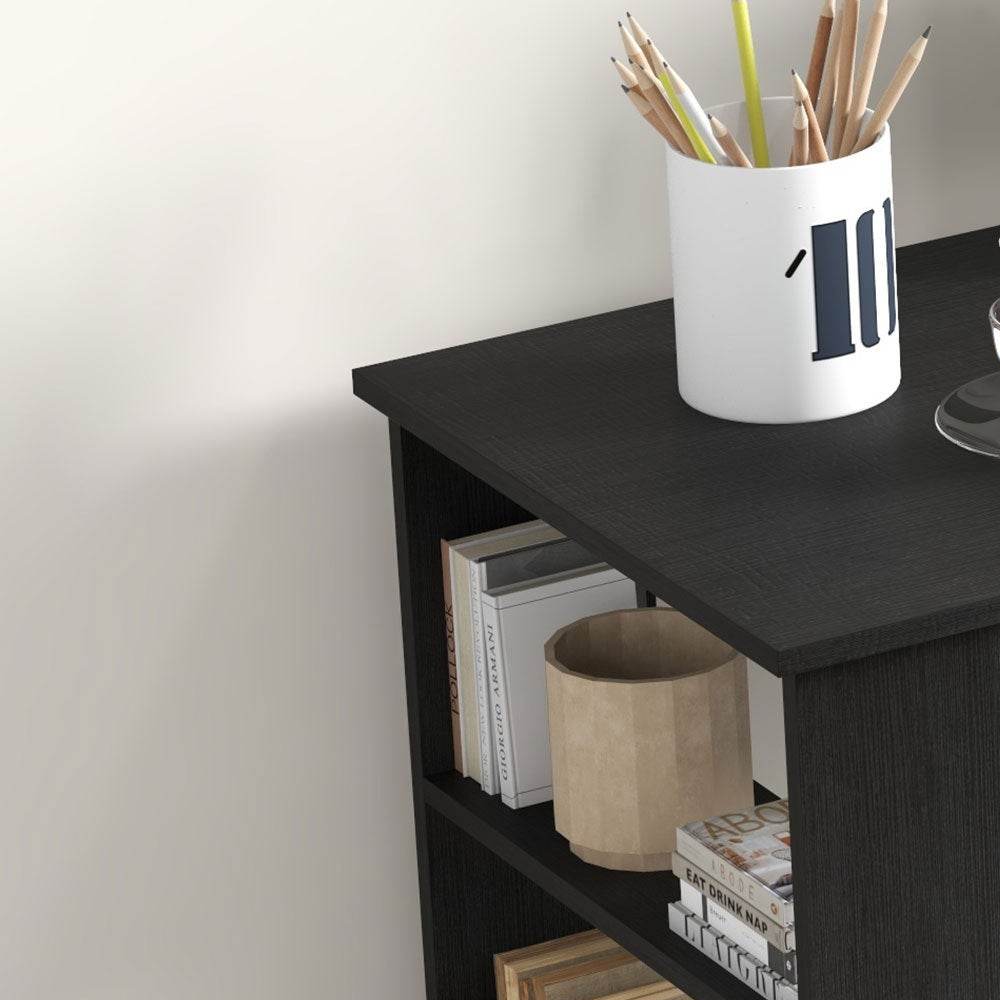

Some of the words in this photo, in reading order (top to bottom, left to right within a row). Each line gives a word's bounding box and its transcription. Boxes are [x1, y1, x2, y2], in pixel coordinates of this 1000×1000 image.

[445, 604, 459, 716] POLLOCK
[487, 622, 500, 697] ARMANI
[494, 703, 507, 782] GIORGIO
[702, 800, 789, 840] ABO
[686, 867, 706, 892] EAT
[709, 882, 743, 917] DRINK
[746, 910, 769, 934] NAP
